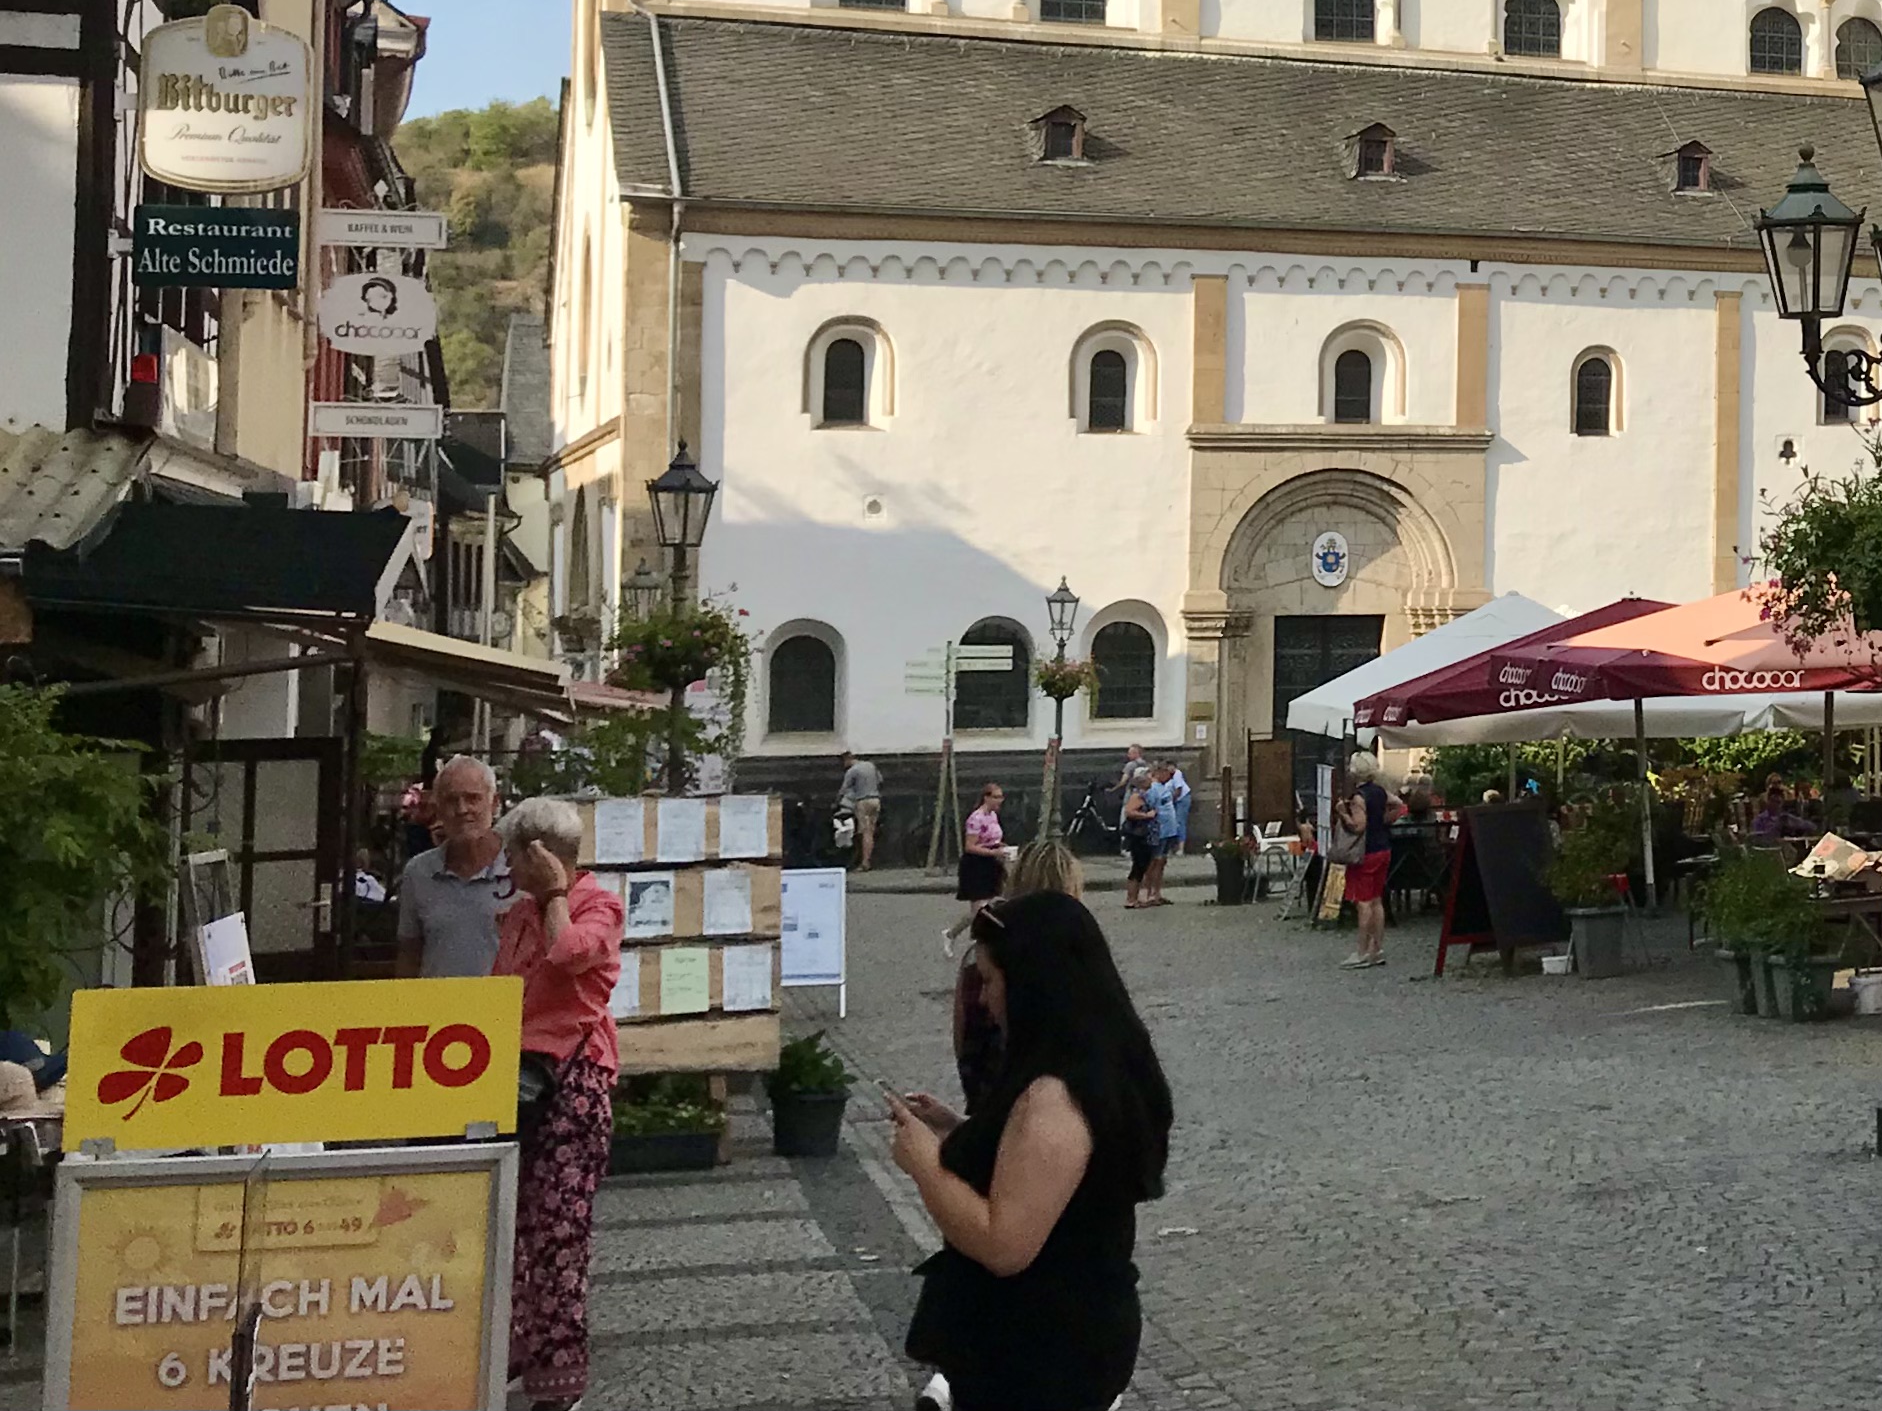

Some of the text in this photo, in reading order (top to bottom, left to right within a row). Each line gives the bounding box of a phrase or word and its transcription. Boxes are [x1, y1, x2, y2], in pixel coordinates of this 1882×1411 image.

[156, 74, 297, 121] Bitburger
[147, 218, 293, 238] Restaurant
[137, 247, 294, 277] Alte Schmiede
[219, 1024, 492, 1096] LOTTO
[350, 1272, 454, 1312] MAL
[158, 1338, 405, 1387] 6 KREUZE
